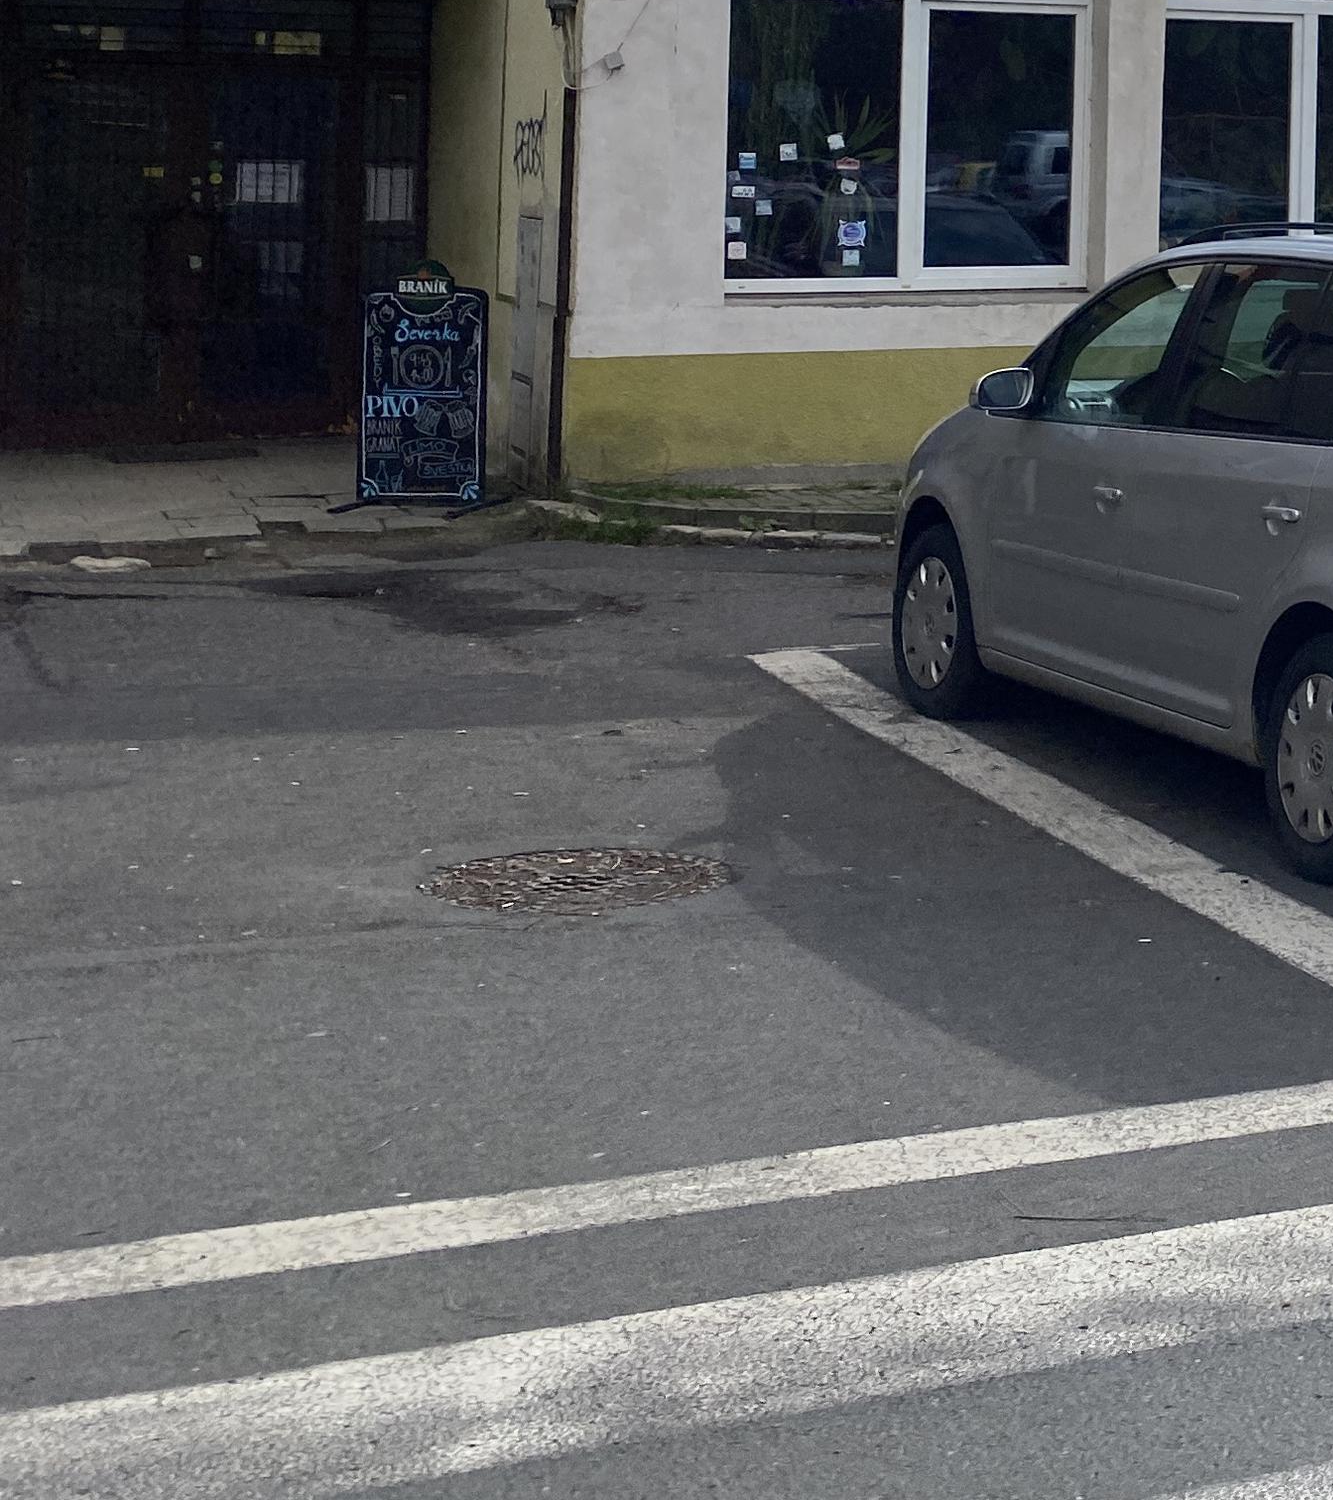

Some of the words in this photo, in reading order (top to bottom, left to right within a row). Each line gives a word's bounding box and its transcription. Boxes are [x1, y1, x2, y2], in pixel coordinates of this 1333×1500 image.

[398, 278, 448, 294] BRANÍK
[395, 318, 461, 342] Severka
[365, 395, 419, 418] PIVO
